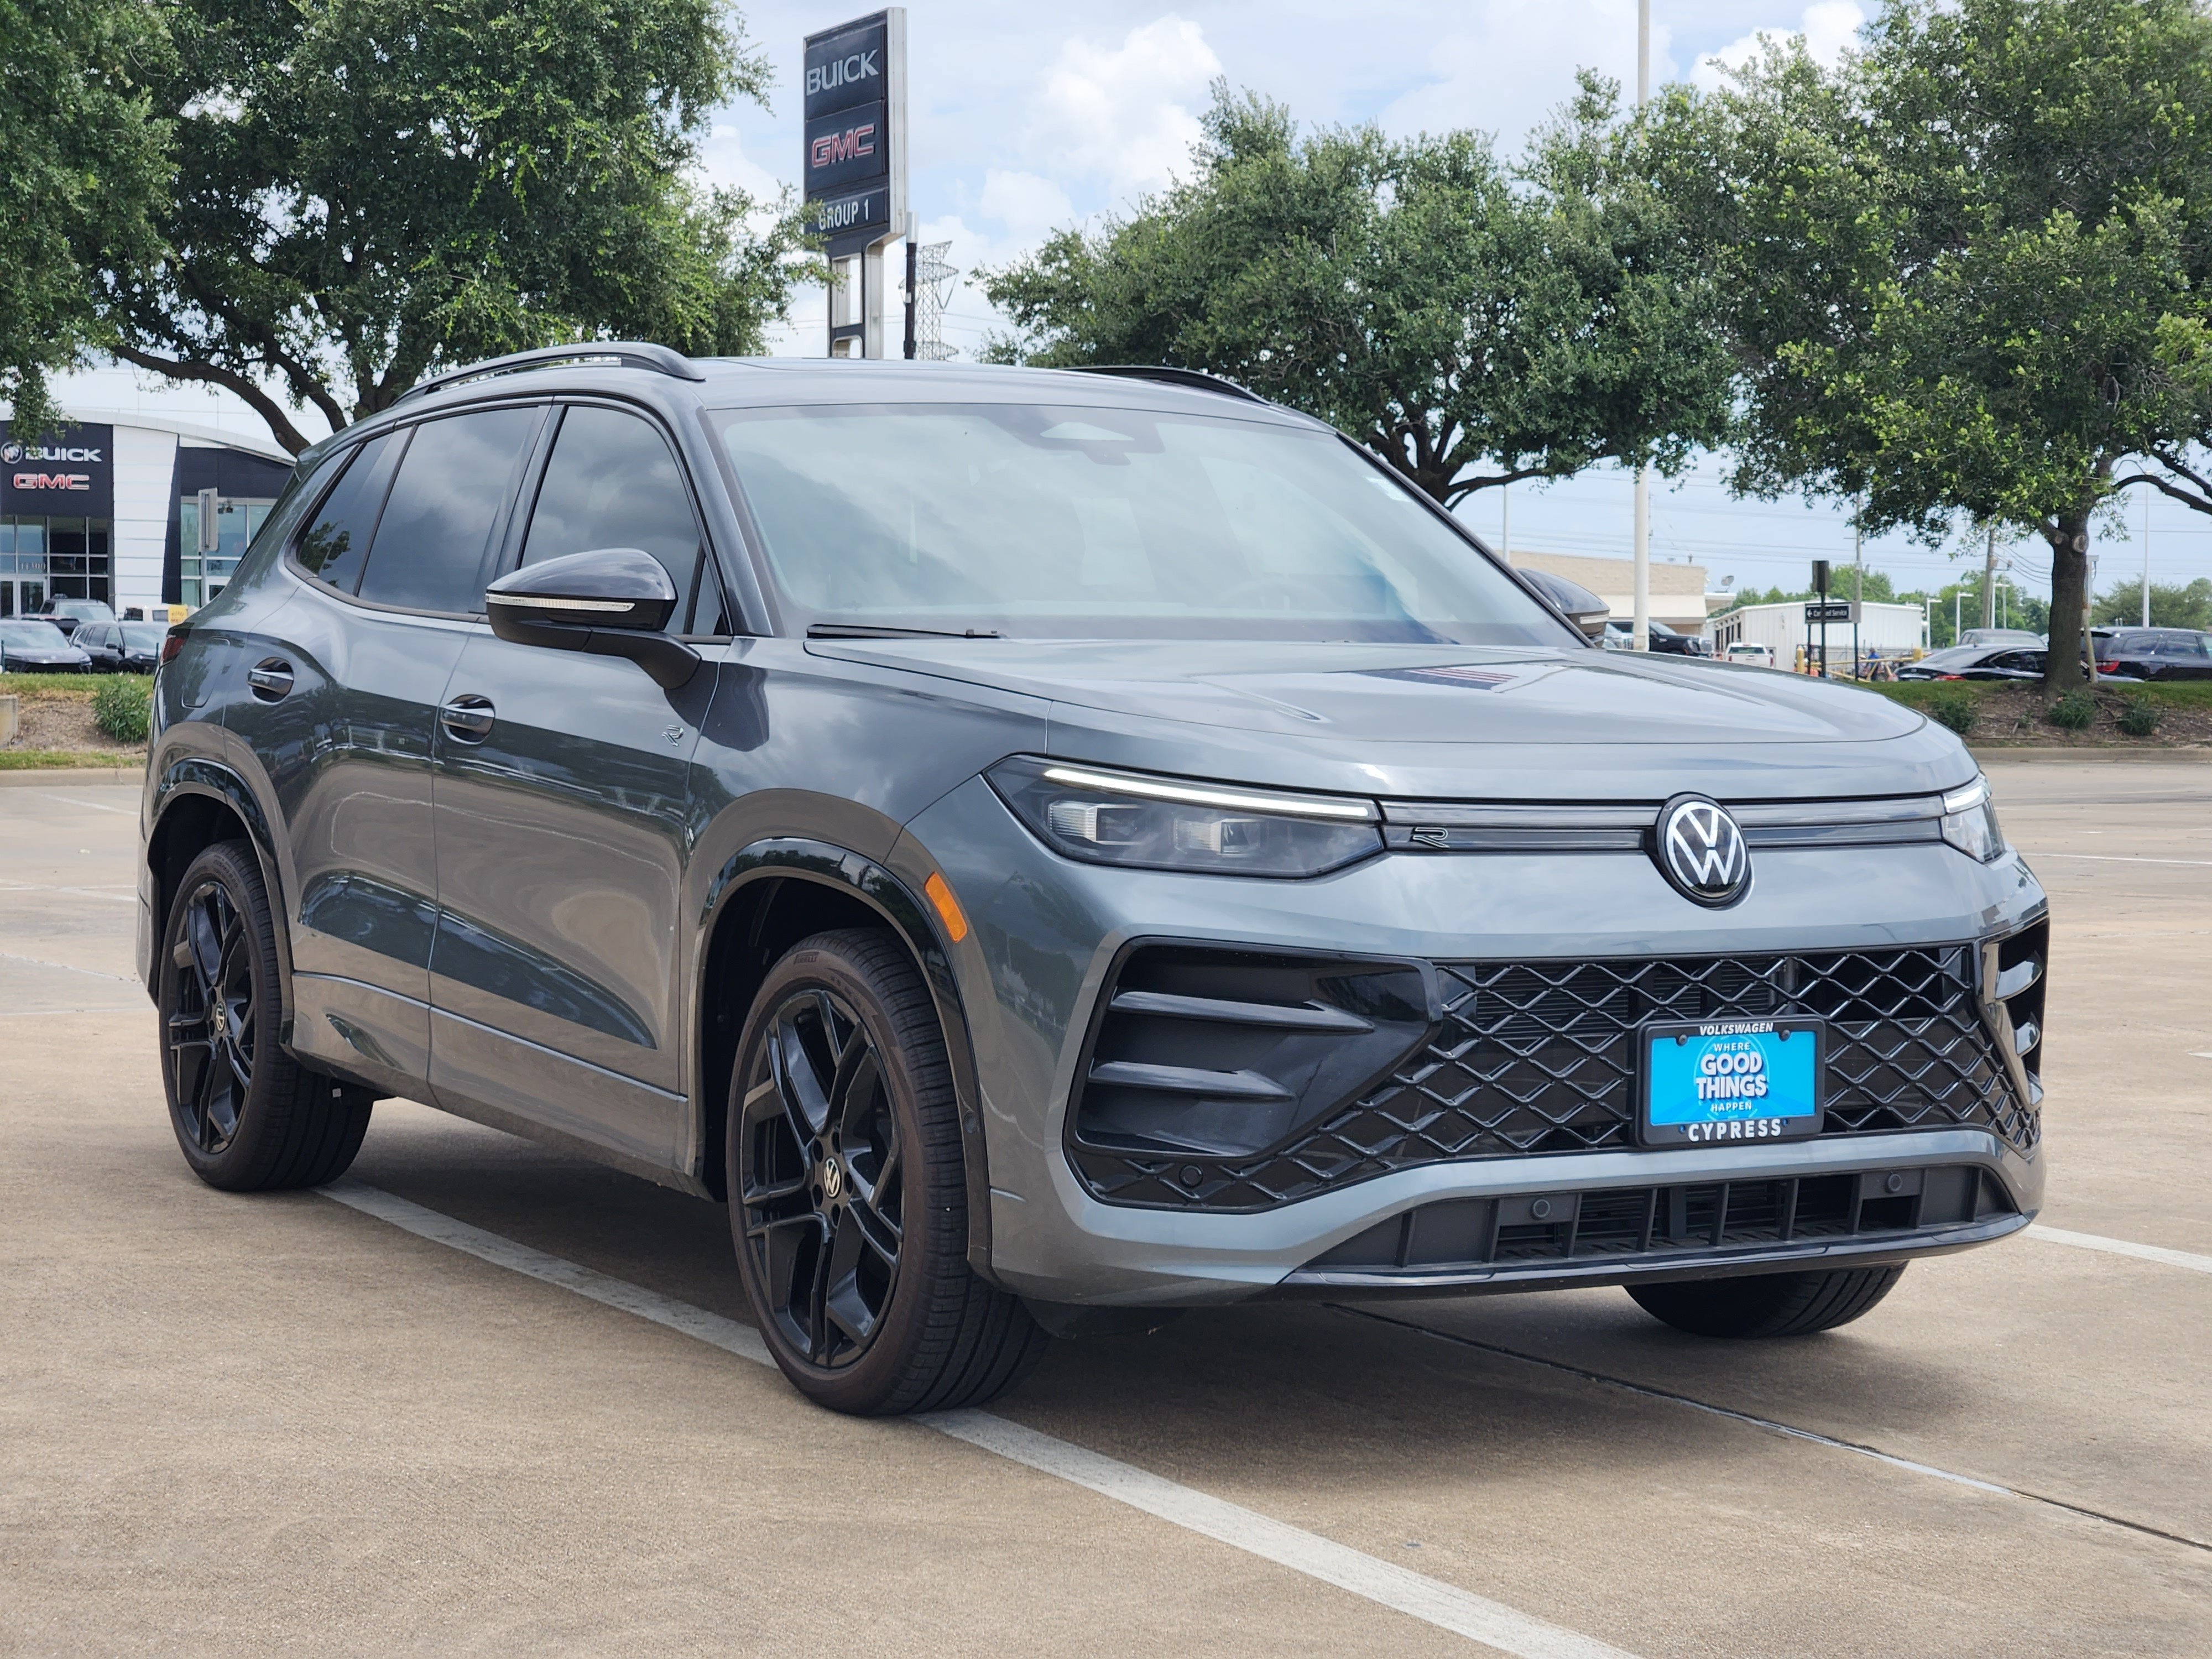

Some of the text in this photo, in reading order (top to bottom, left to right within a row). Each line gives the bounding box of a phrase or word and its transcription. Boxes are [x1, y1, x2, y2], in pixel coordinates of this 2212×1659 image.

[806, 49, 879, 96] BUICK
[812, 123, 875, 168] GMC
[818, 198, 869, 231] GROUP 1
[13, 473, 90, 490] GMC
[1699, 1022, 1773, 1036] VOLKSWAGEN
[1714, 1042, 1750, 1052] WHERE
[1700, 1052, 1762, 1075] GOOD
[1696, 1074, 1767, 1099] THINGS
[1711, 1102, 1752, 1112] HAPPEN
[1688, 1119, 1781, 1142] CYPRESS
